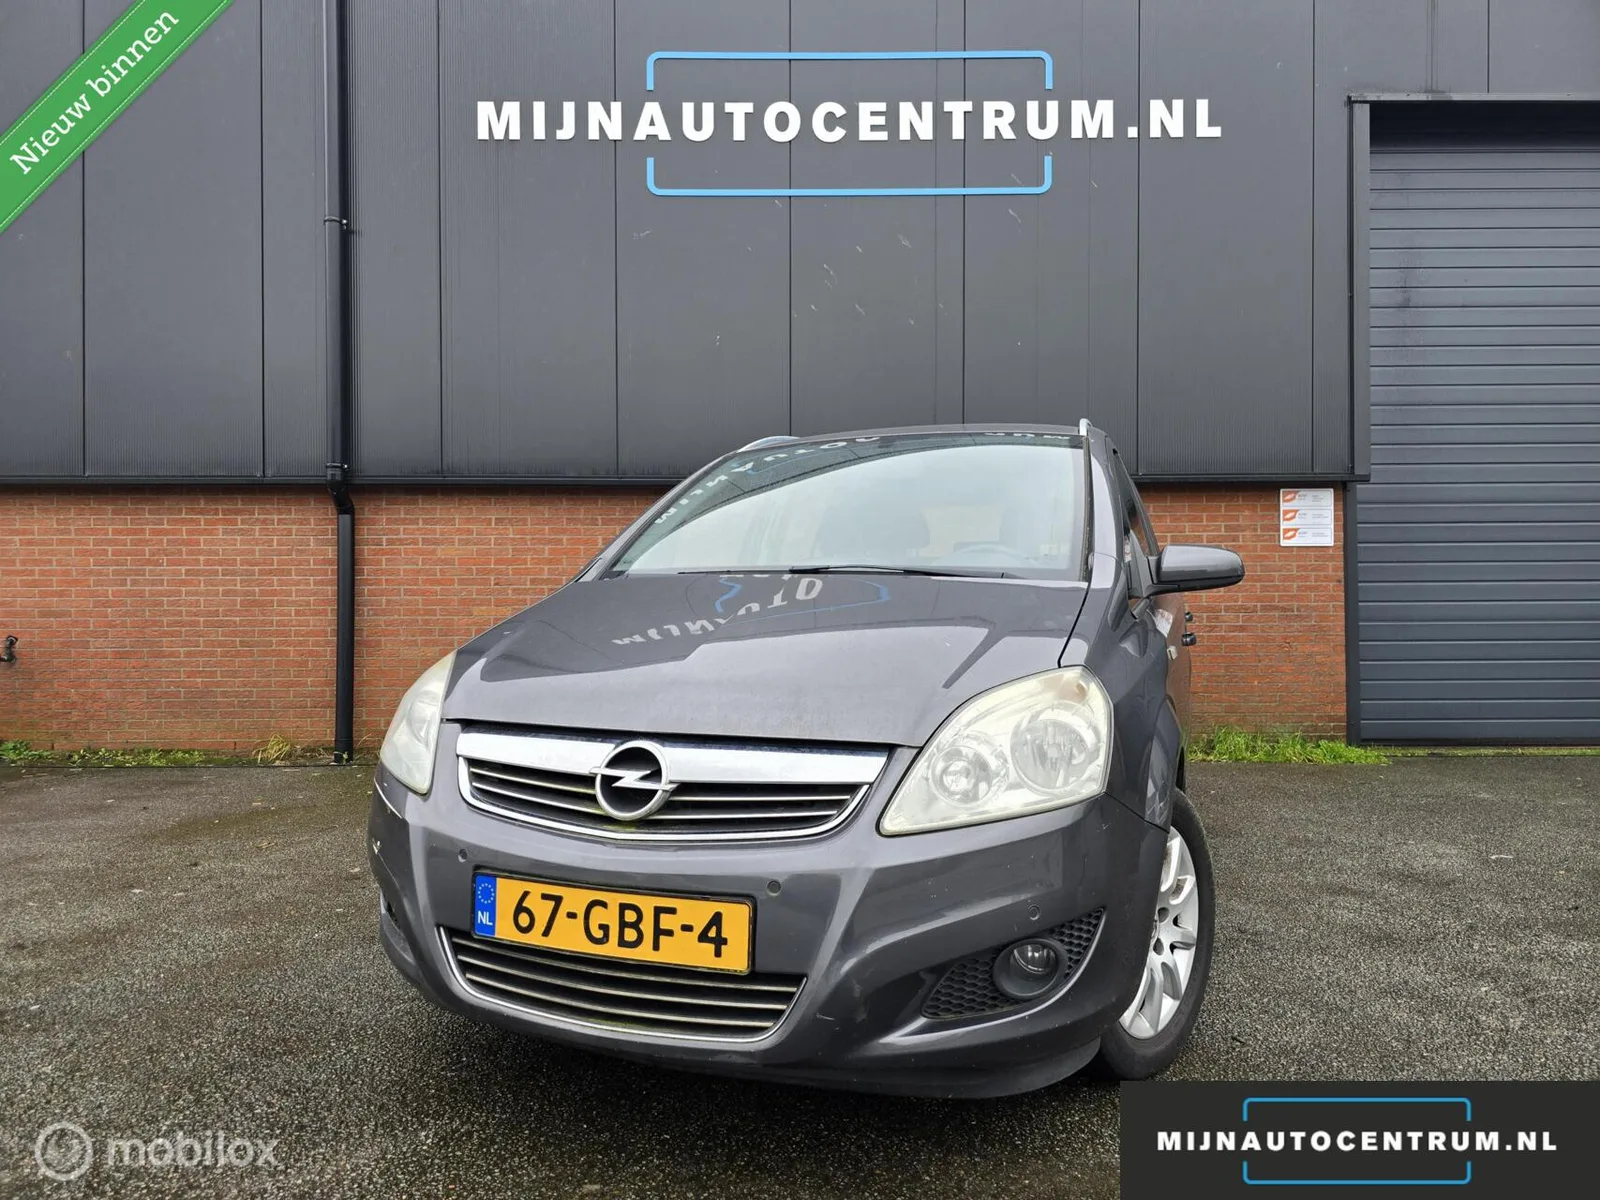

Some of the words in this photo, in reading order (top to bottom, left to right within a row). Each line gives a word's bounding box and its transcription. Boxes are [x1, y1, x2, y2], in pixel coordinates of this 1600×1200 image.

[476, 98, 1222, 143] MIJNAUTOCENTRUM.NL
[477, 910, 494, 927] NL
[512, 889, 729, 959] 67-GBF-4
